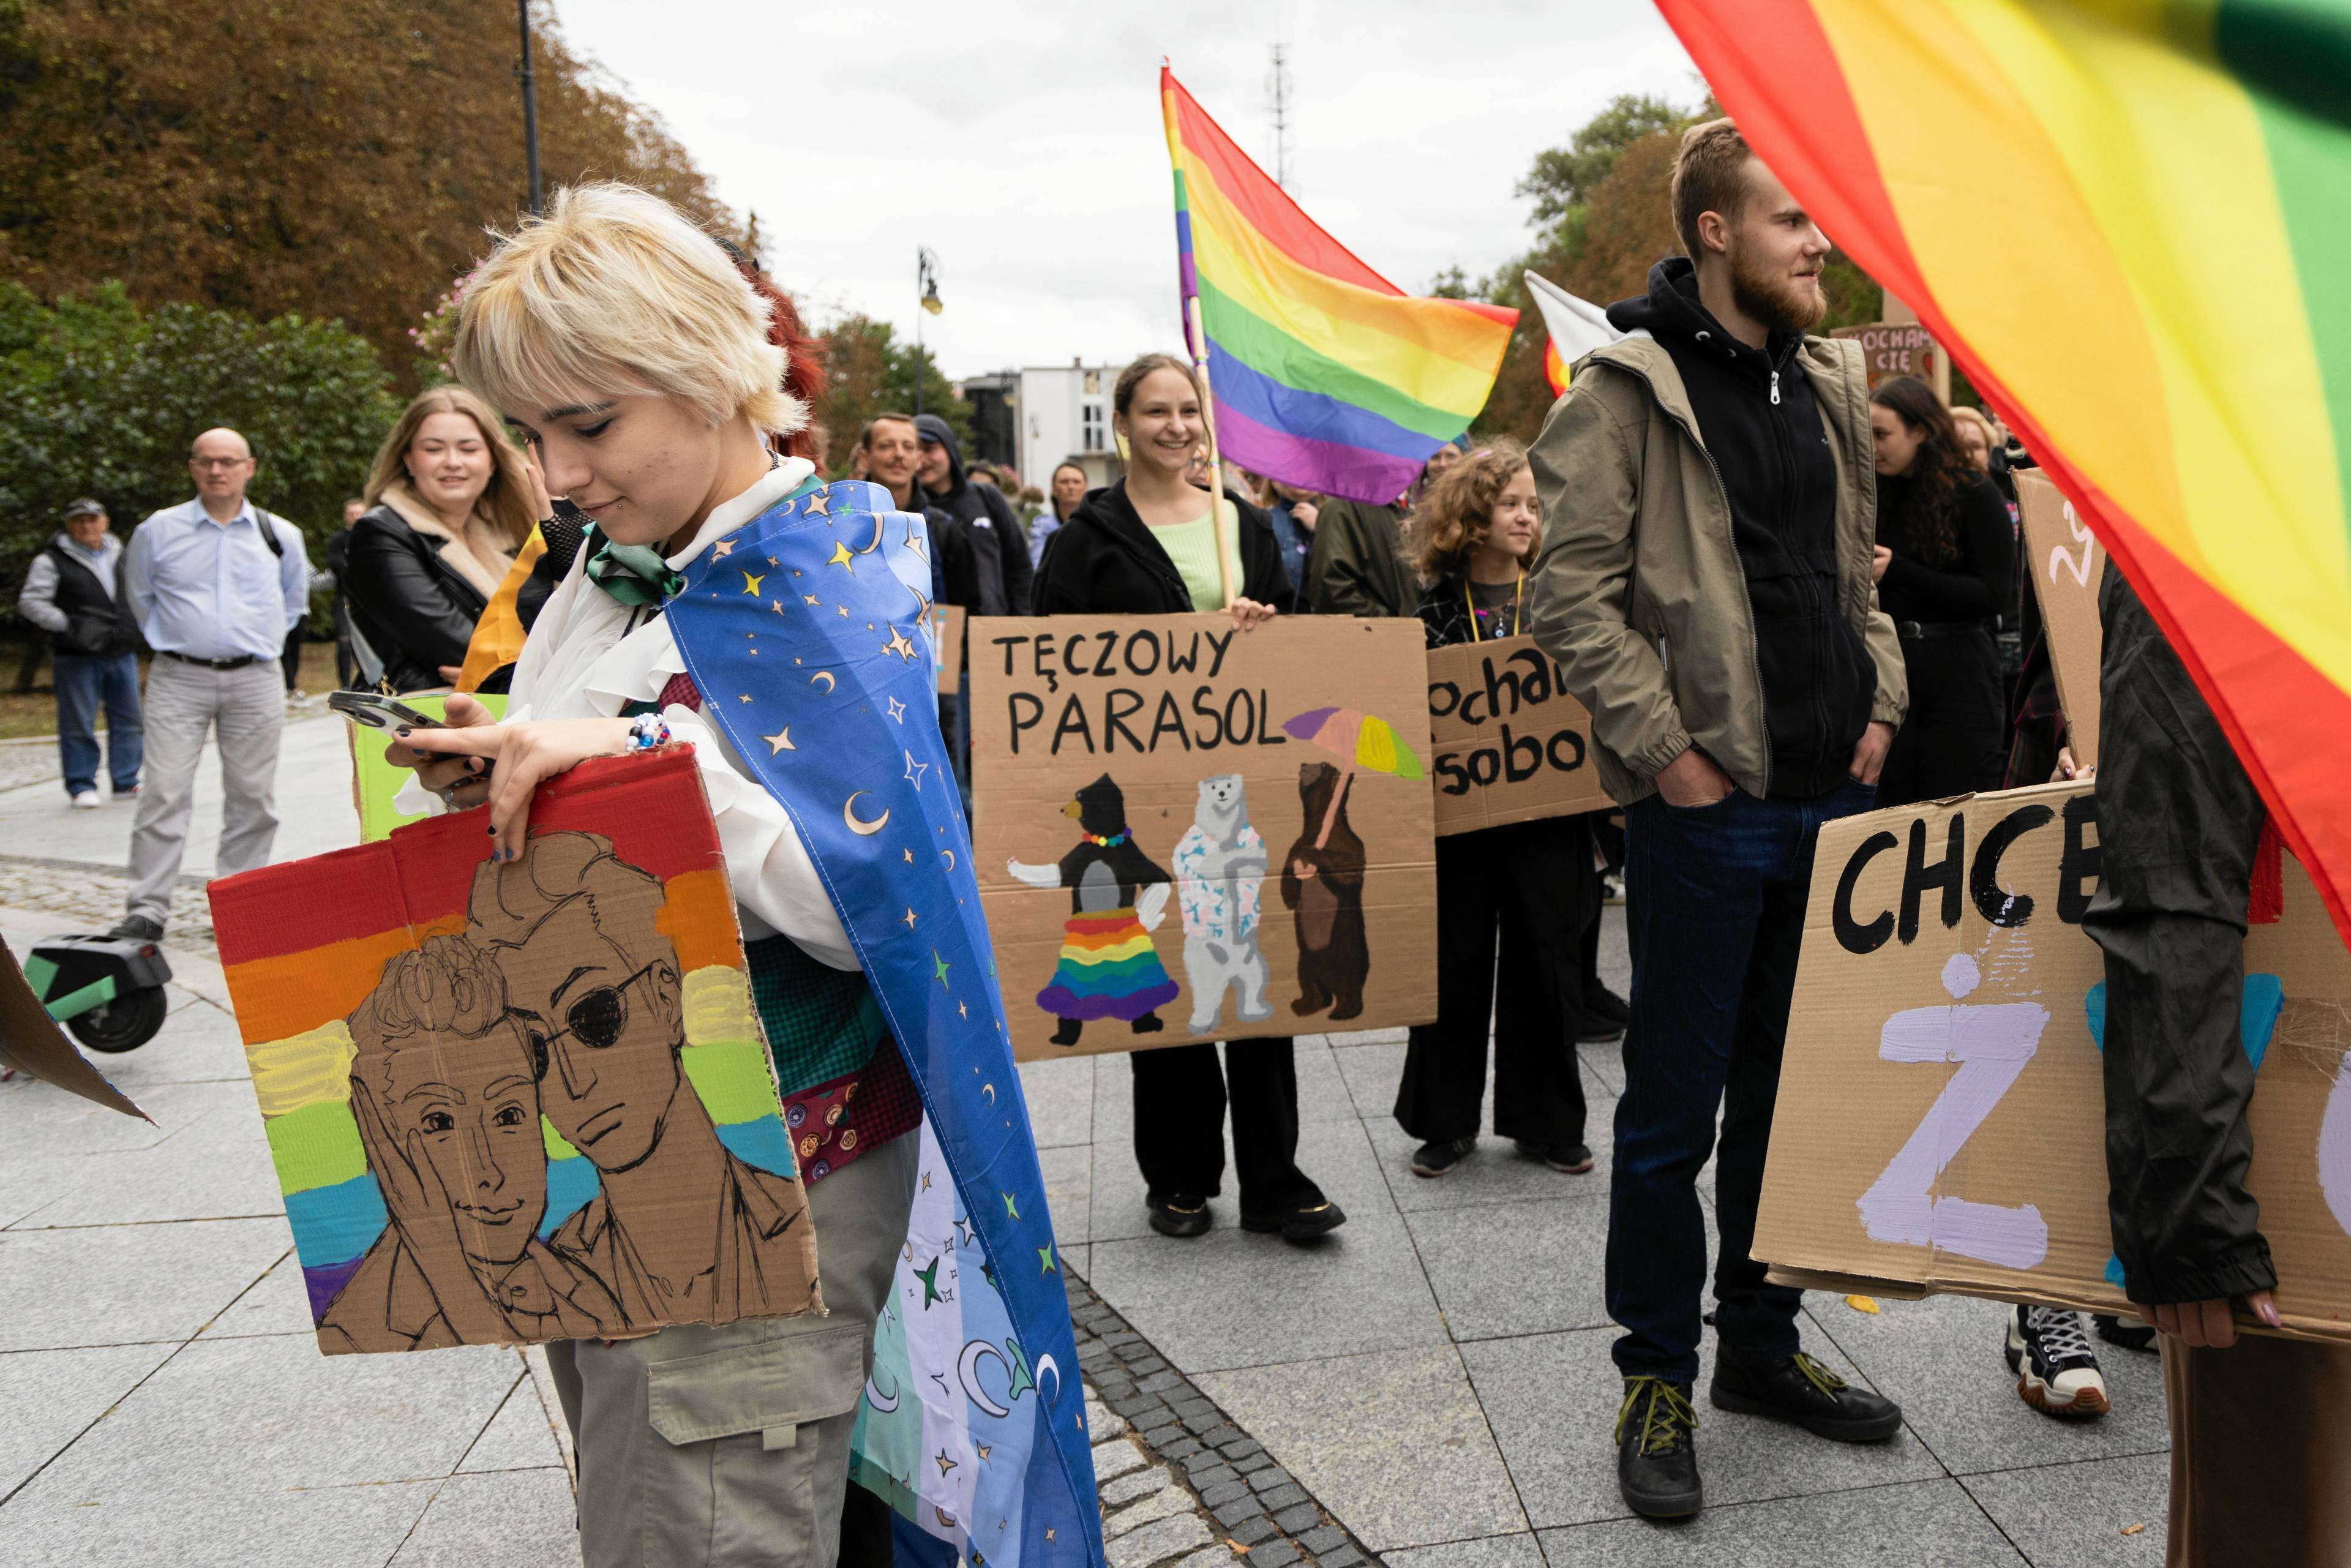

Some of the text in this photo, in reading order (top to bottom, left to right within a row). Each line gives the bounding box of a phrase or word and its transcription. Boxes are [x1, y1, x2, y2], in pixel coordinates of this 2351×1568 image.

[991, 629, 1233, 693] TĘCZOWY
[1428, 648, 1568, 726] ocha
[1008, 685, 1286, 755] PARASOL
[1433, 723, 1586, 796] sobo
